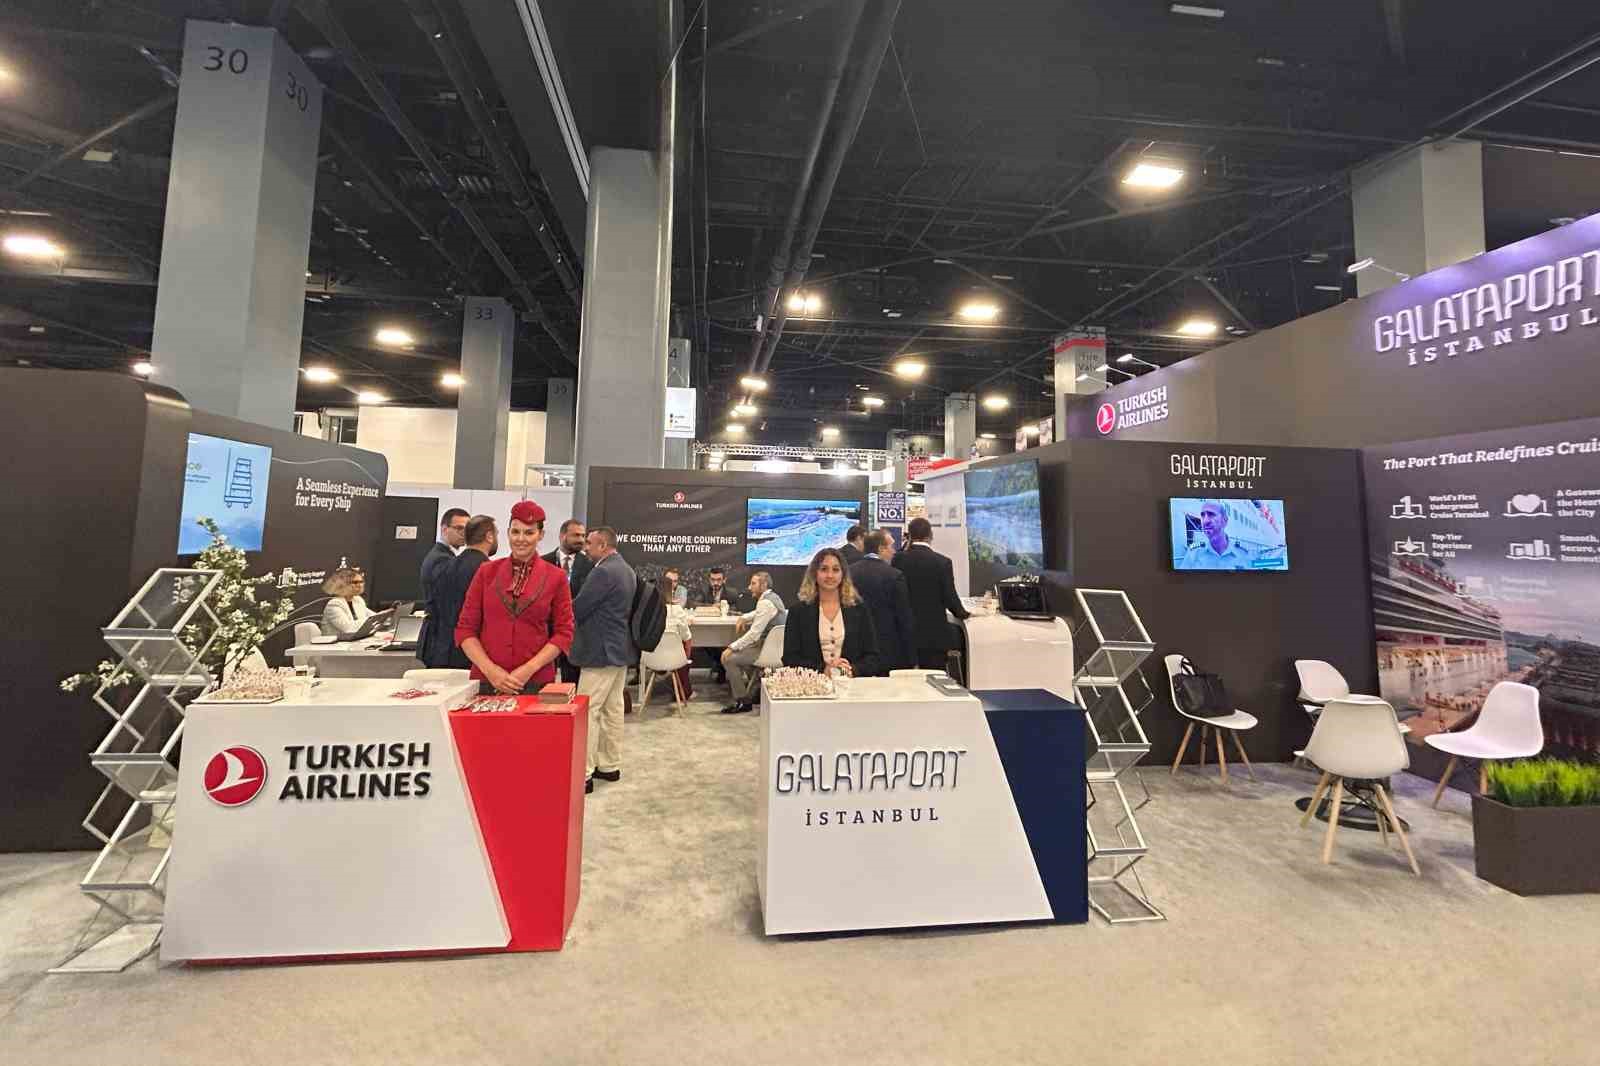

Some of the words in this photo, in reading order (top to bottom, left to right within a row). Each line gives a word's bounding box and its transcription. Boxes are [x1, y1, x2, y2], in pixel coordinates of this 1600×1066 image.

[202, 46, 248, 74] 30
[286, 72, 308, 112] 30
[474, 307, 493, 320] 33
[1374, 250, 1600, 353] GALATAPORT
[1117, 386, 1168, 414] TURKISH
[1117, 403, 1169, 430] AIRLINES
[1170, 454, 1266, 477] GALATAPORT
[1384, 459, 1406, 470] The
[1408, 455, 1437, 468] Port
[1439, 452, 1473, 465] That
[1475, 446, 1554, 462] Redefines
[296, 478, 306, 490] A
[306, 478, 343, 494] Seamless
[342, 482, 379, 498] Experience
[296, 493, 309, 507] for
[311, 494, 334, 510] Every
[334, 496, 351, 511] Ship
[615, 534, 628, 543] WE
[630, 534, 667, 544] CONNECT
[669, 535, 692, 544] MORE
[694, 535, 737, 545] COUNTRIES
[643, 543, 665, 553] THAN
[667, 543, 684, 553] ANY
[685, 543, 711, 553] OTHER
[284, 743, 431, 770] TURKISH
[776, 750, 968, 793] GALATAPORT
[278, 771, 432, 801] AIRLINES
[805, 808, 939, 826] İSTANBUL
